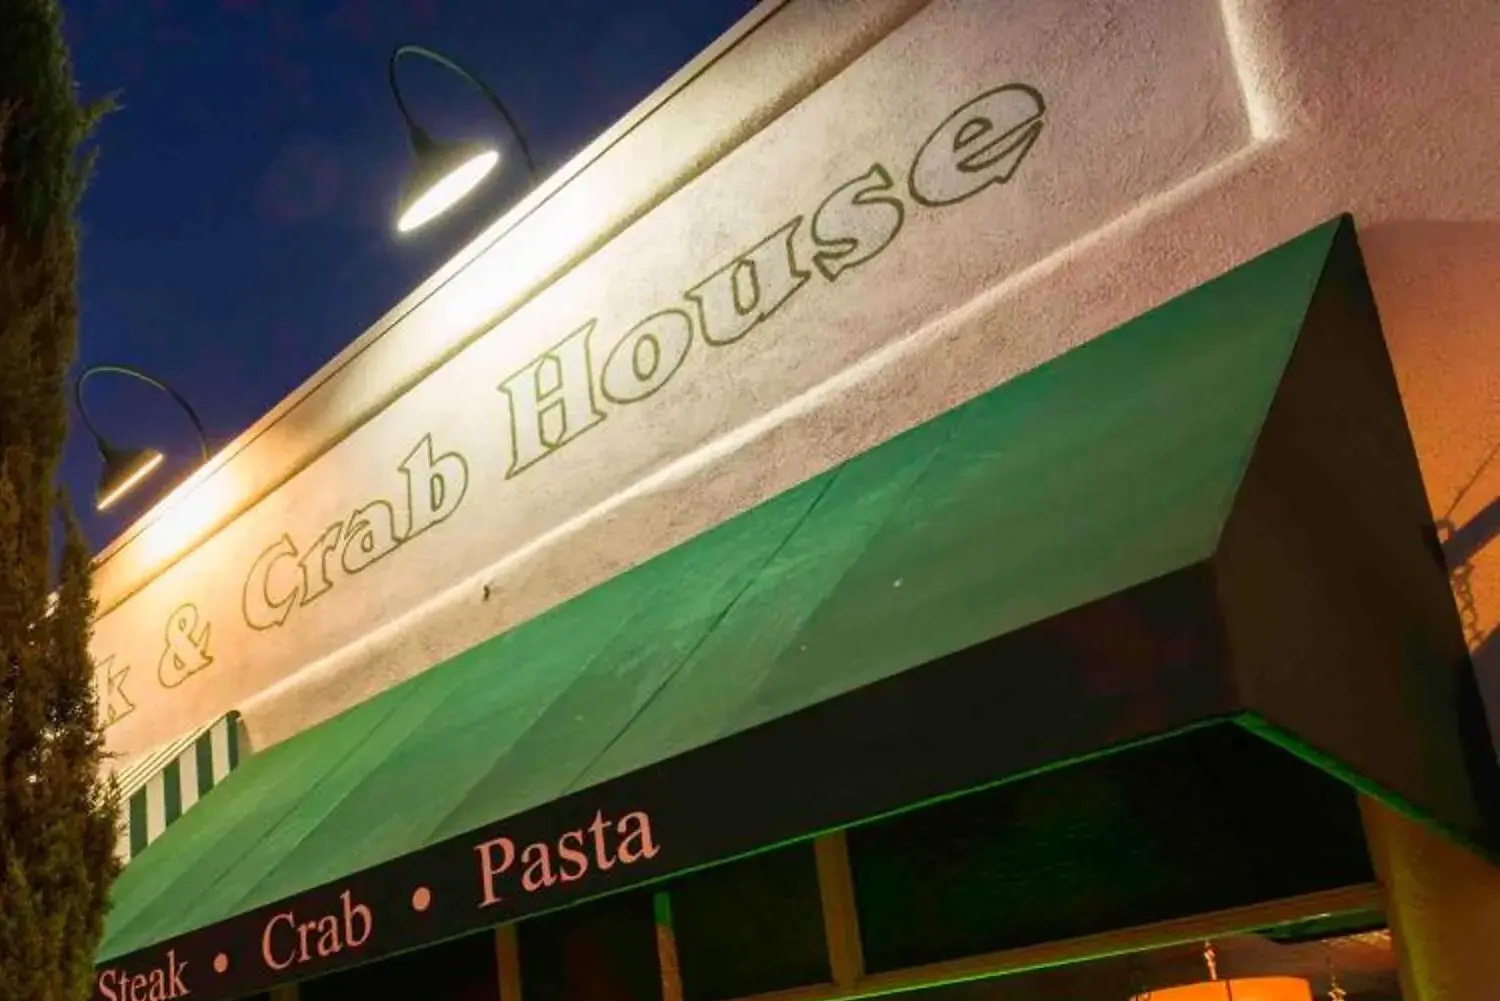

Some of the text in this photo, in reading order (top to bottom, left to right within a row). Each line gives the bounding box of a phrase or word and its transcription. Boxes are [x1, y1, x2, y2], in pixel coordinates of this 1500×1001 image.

[156, 82, 1047, 689] & Crab House
[261, 889, 374, 971] Crab
[473, 809, 661, 909] Pasta
